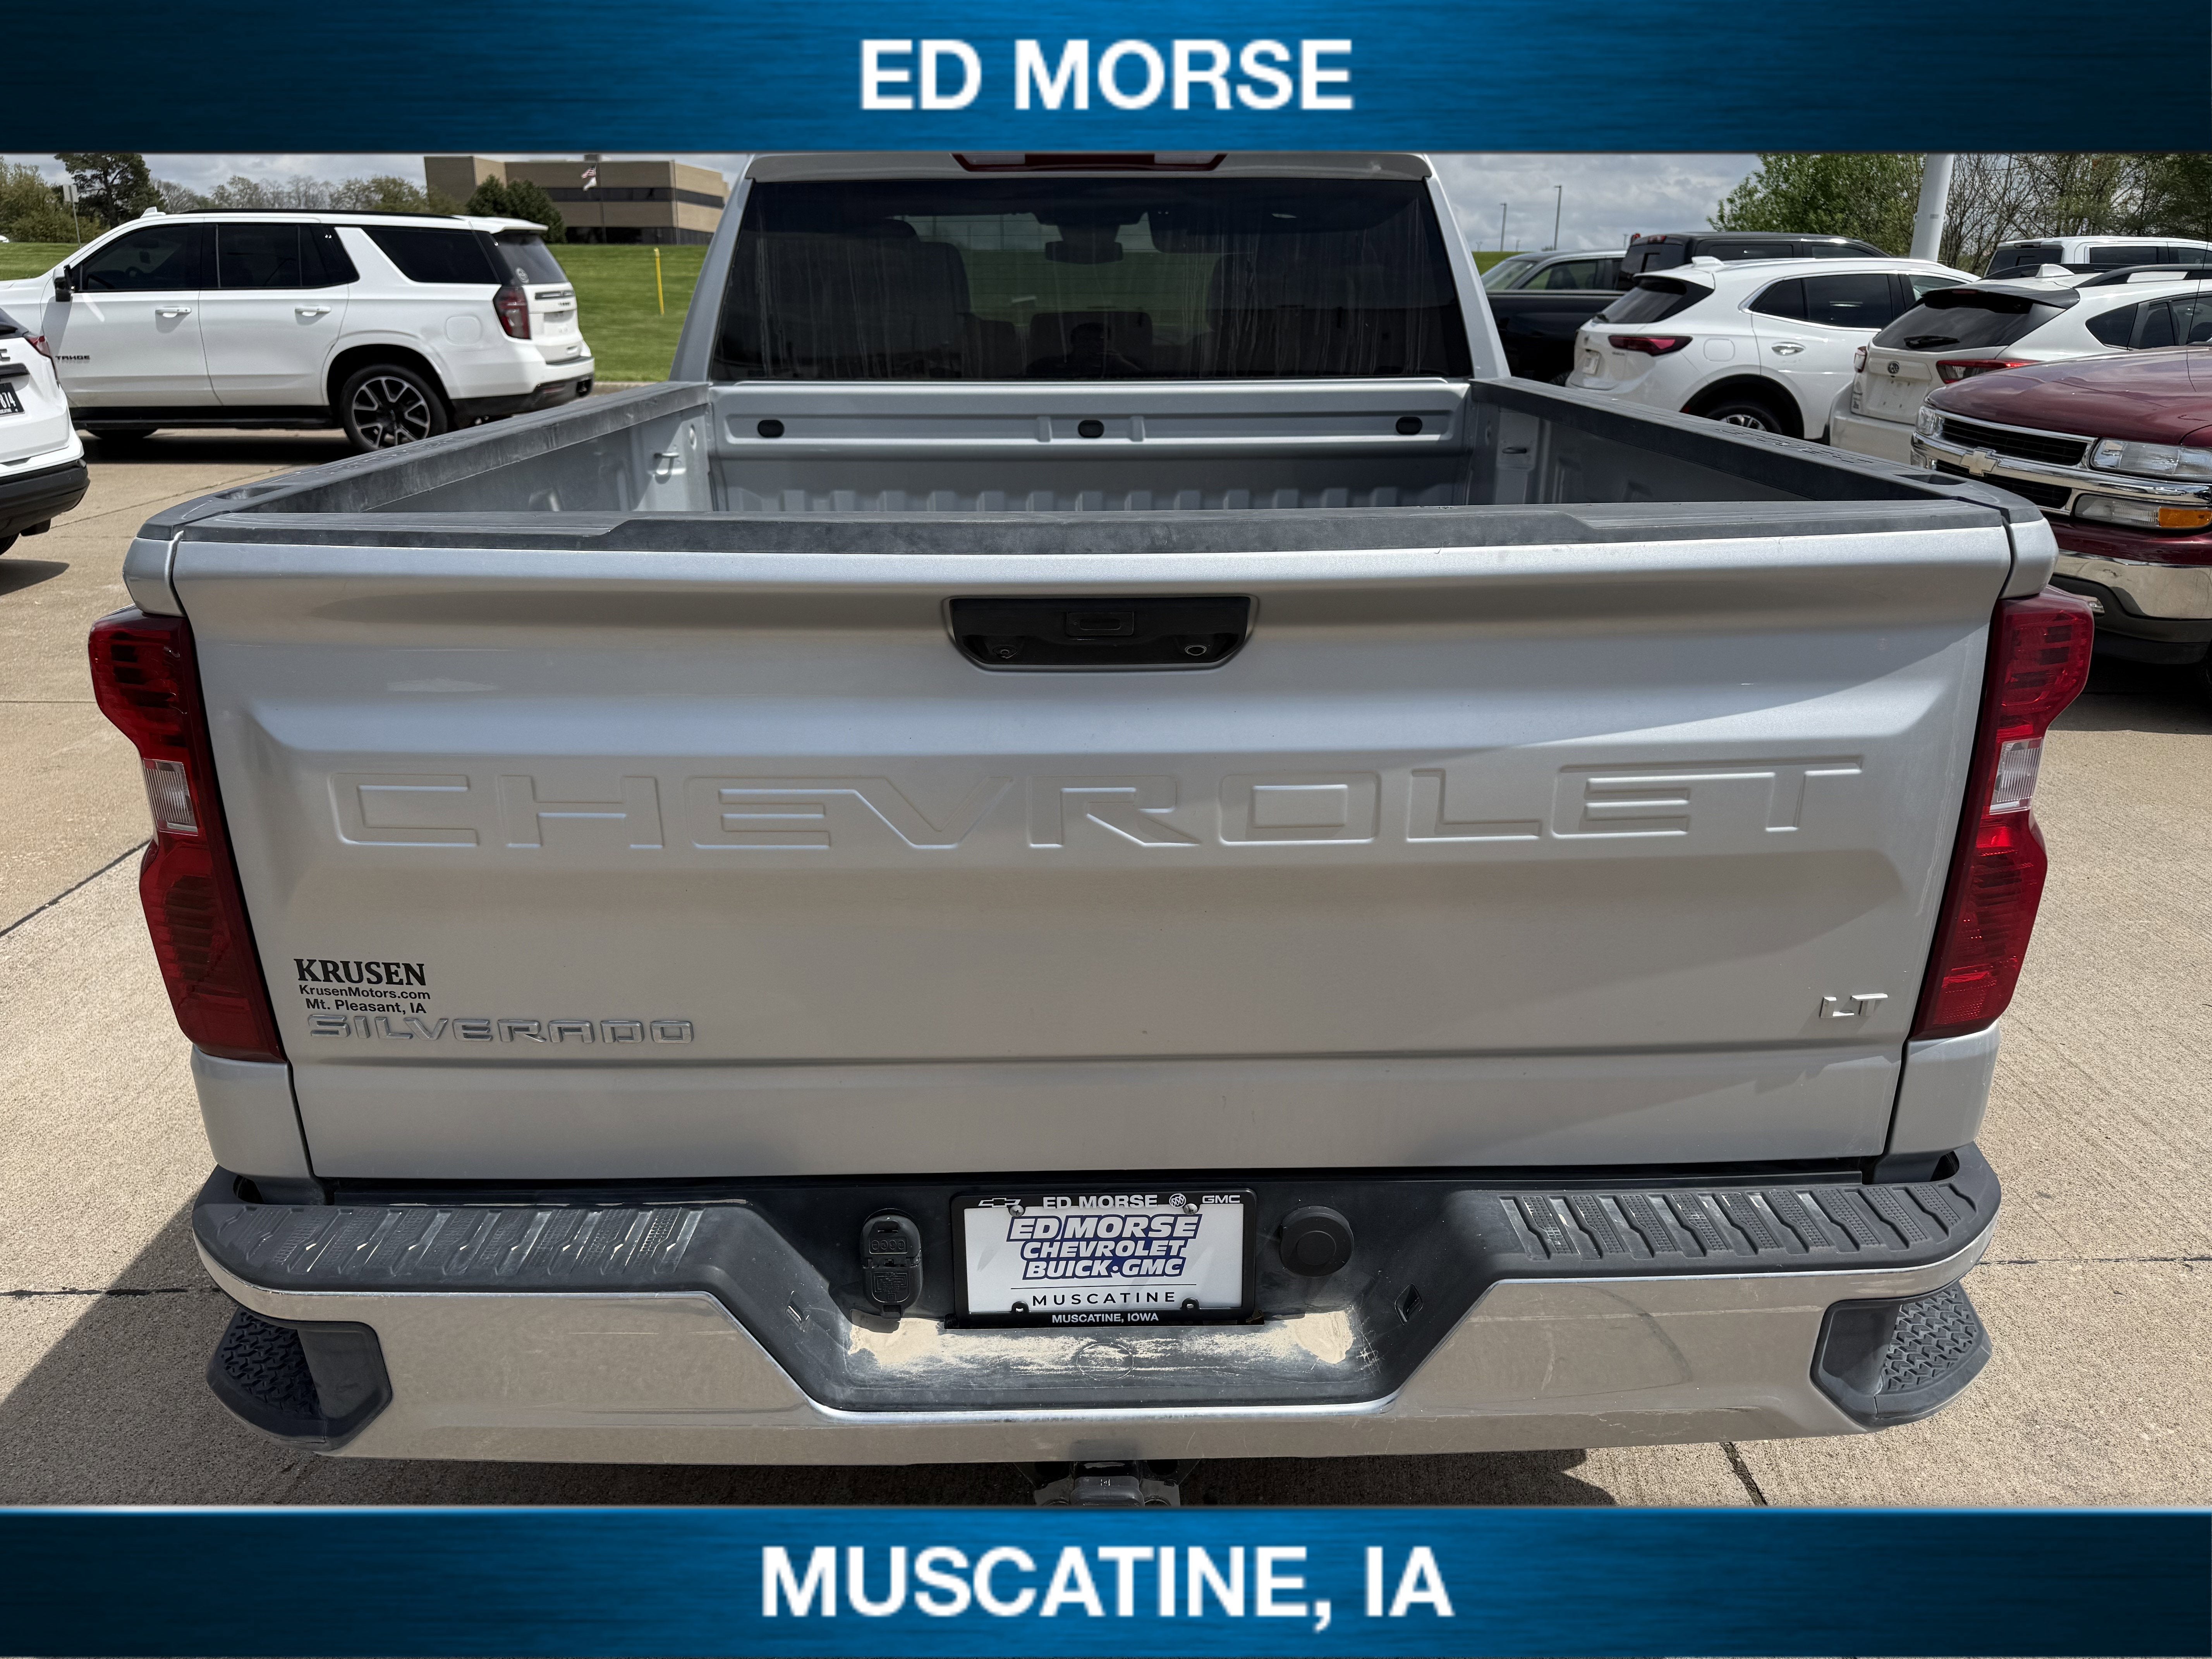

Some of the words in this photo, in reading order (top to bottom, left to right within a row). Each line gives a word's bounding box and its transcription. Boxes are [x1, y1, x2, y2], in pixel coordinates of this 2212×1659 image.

[330, 755, 1863, 849] CHEVROLET
[294, 958, 426, 986] KRUSEN
[299, 984, 431, 1000] KrusenMotors.com
[306, 998, 330, 1010] Mt.
[335, 999, 406, 1015] Pleasant,
[410, 1002, 427, 1013] IA
[1819, 993, 1889, 1018] LT
[307, 1014, 695, 1044] SILVERADO
[1043, 1196, 1072, 1209] ED
[1079, 1194, 1158, 1209] MORSE
[1202, 1195, 1240, 1204] GMC
[1008, 1217, 1060, 1240] ED
[1063, 1215, 1200, 1240] MORSE
[1022, 1239, 1186, 1259] CHEVROLET
[1032, 1291, 1175, 1306] MUSCATINE
[1052, 1313, 1124, 1323] MUSCATINE,
[1127, 1313, 1159, 1321] IOWA
